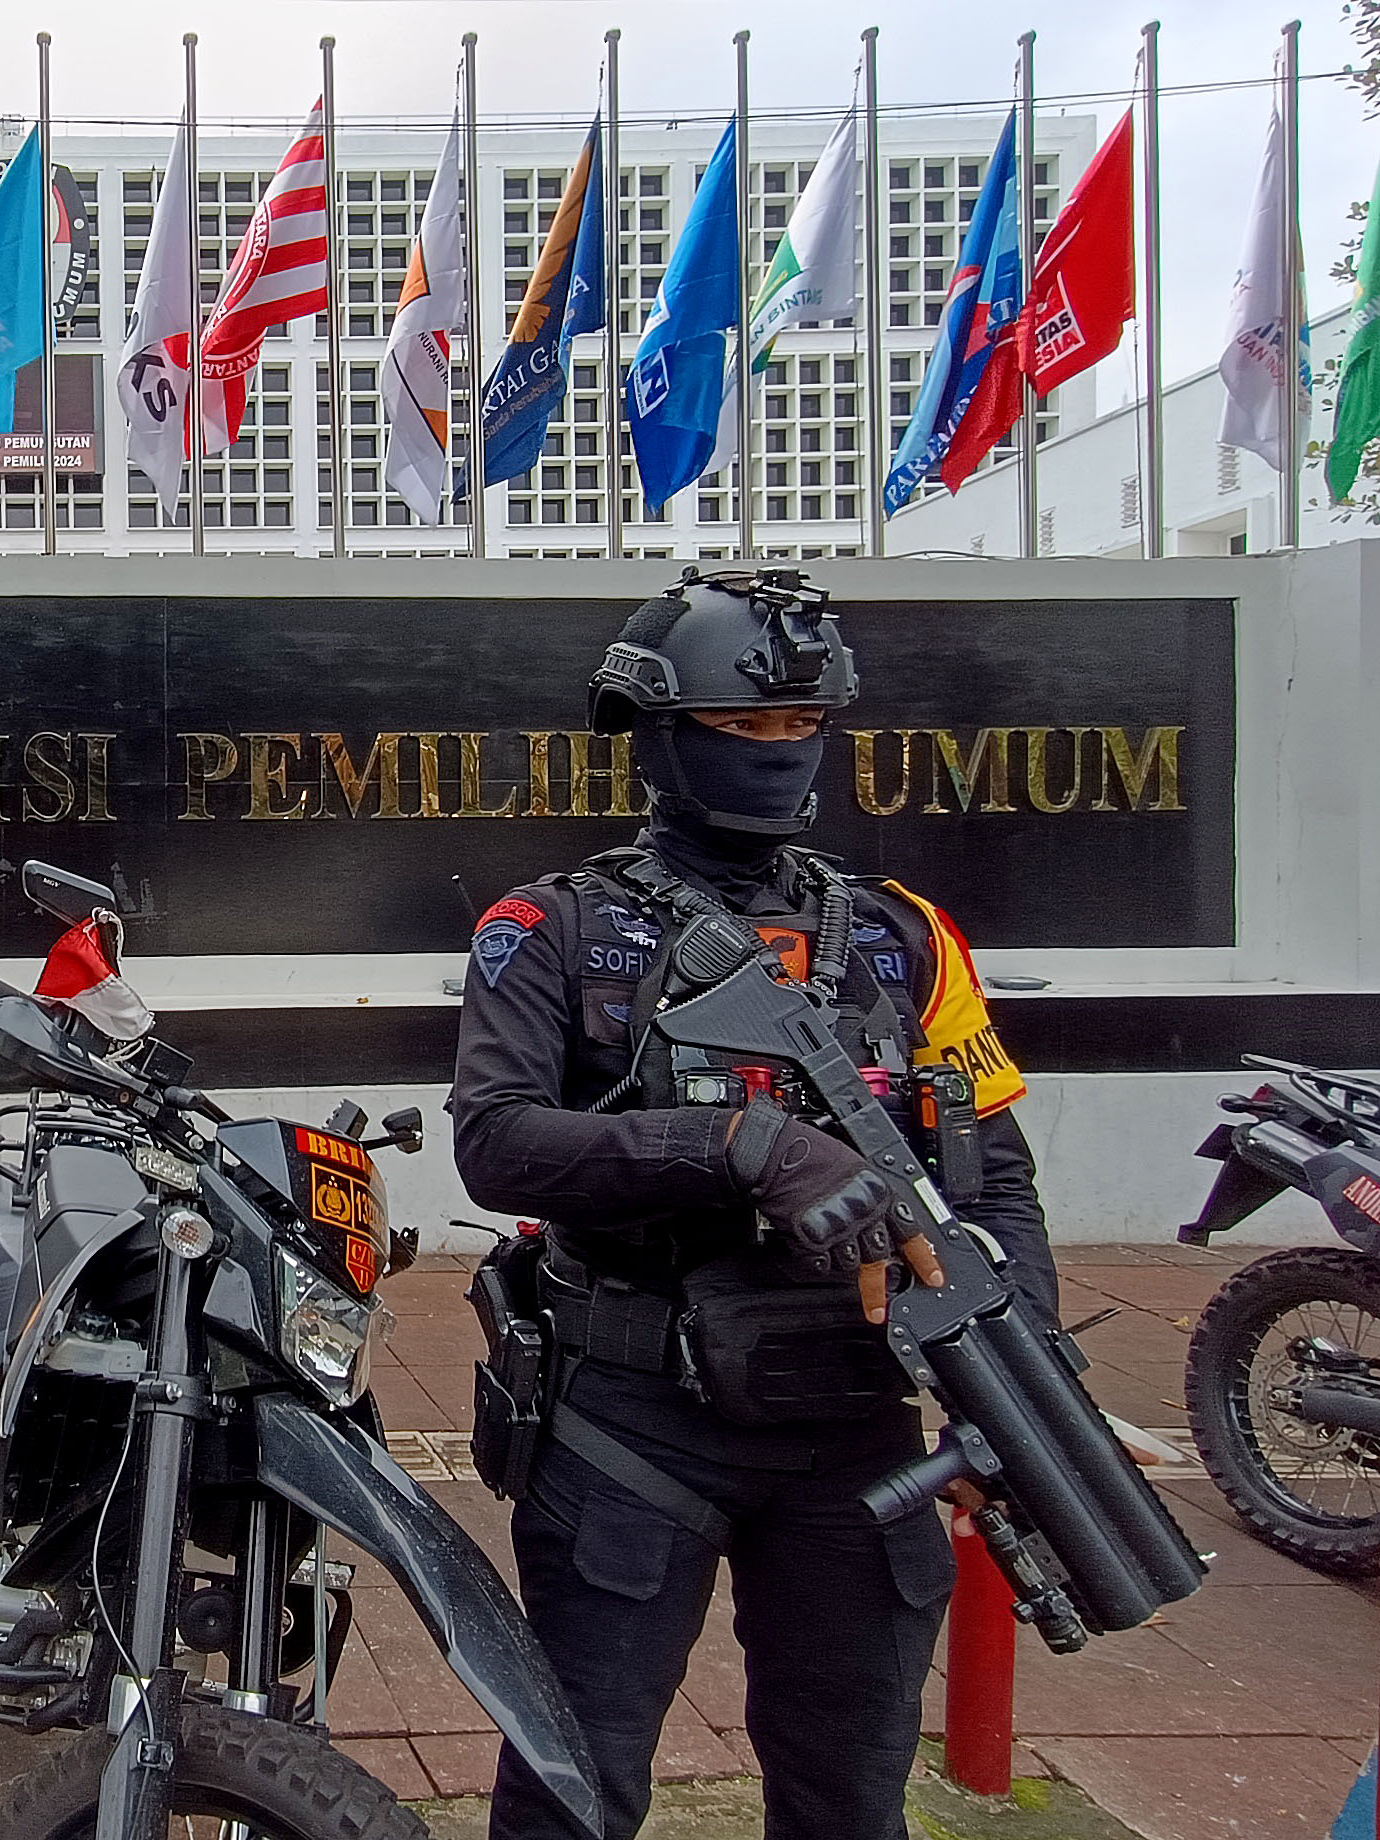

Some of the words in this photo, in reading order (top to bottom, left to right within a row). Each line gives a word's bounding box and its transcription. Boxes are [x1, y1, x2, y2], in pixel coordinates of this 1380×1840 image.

[52, 252, 86, 318] UMUM
[418, 331, 446, 373] NURANI
[4, 436, 90, 449] PEMUNUTAN
[54, 455, 82, 467] 2024
[176, 730, 652, 823] PEMILIH
[842, 725, 1188, 816] UMUM
